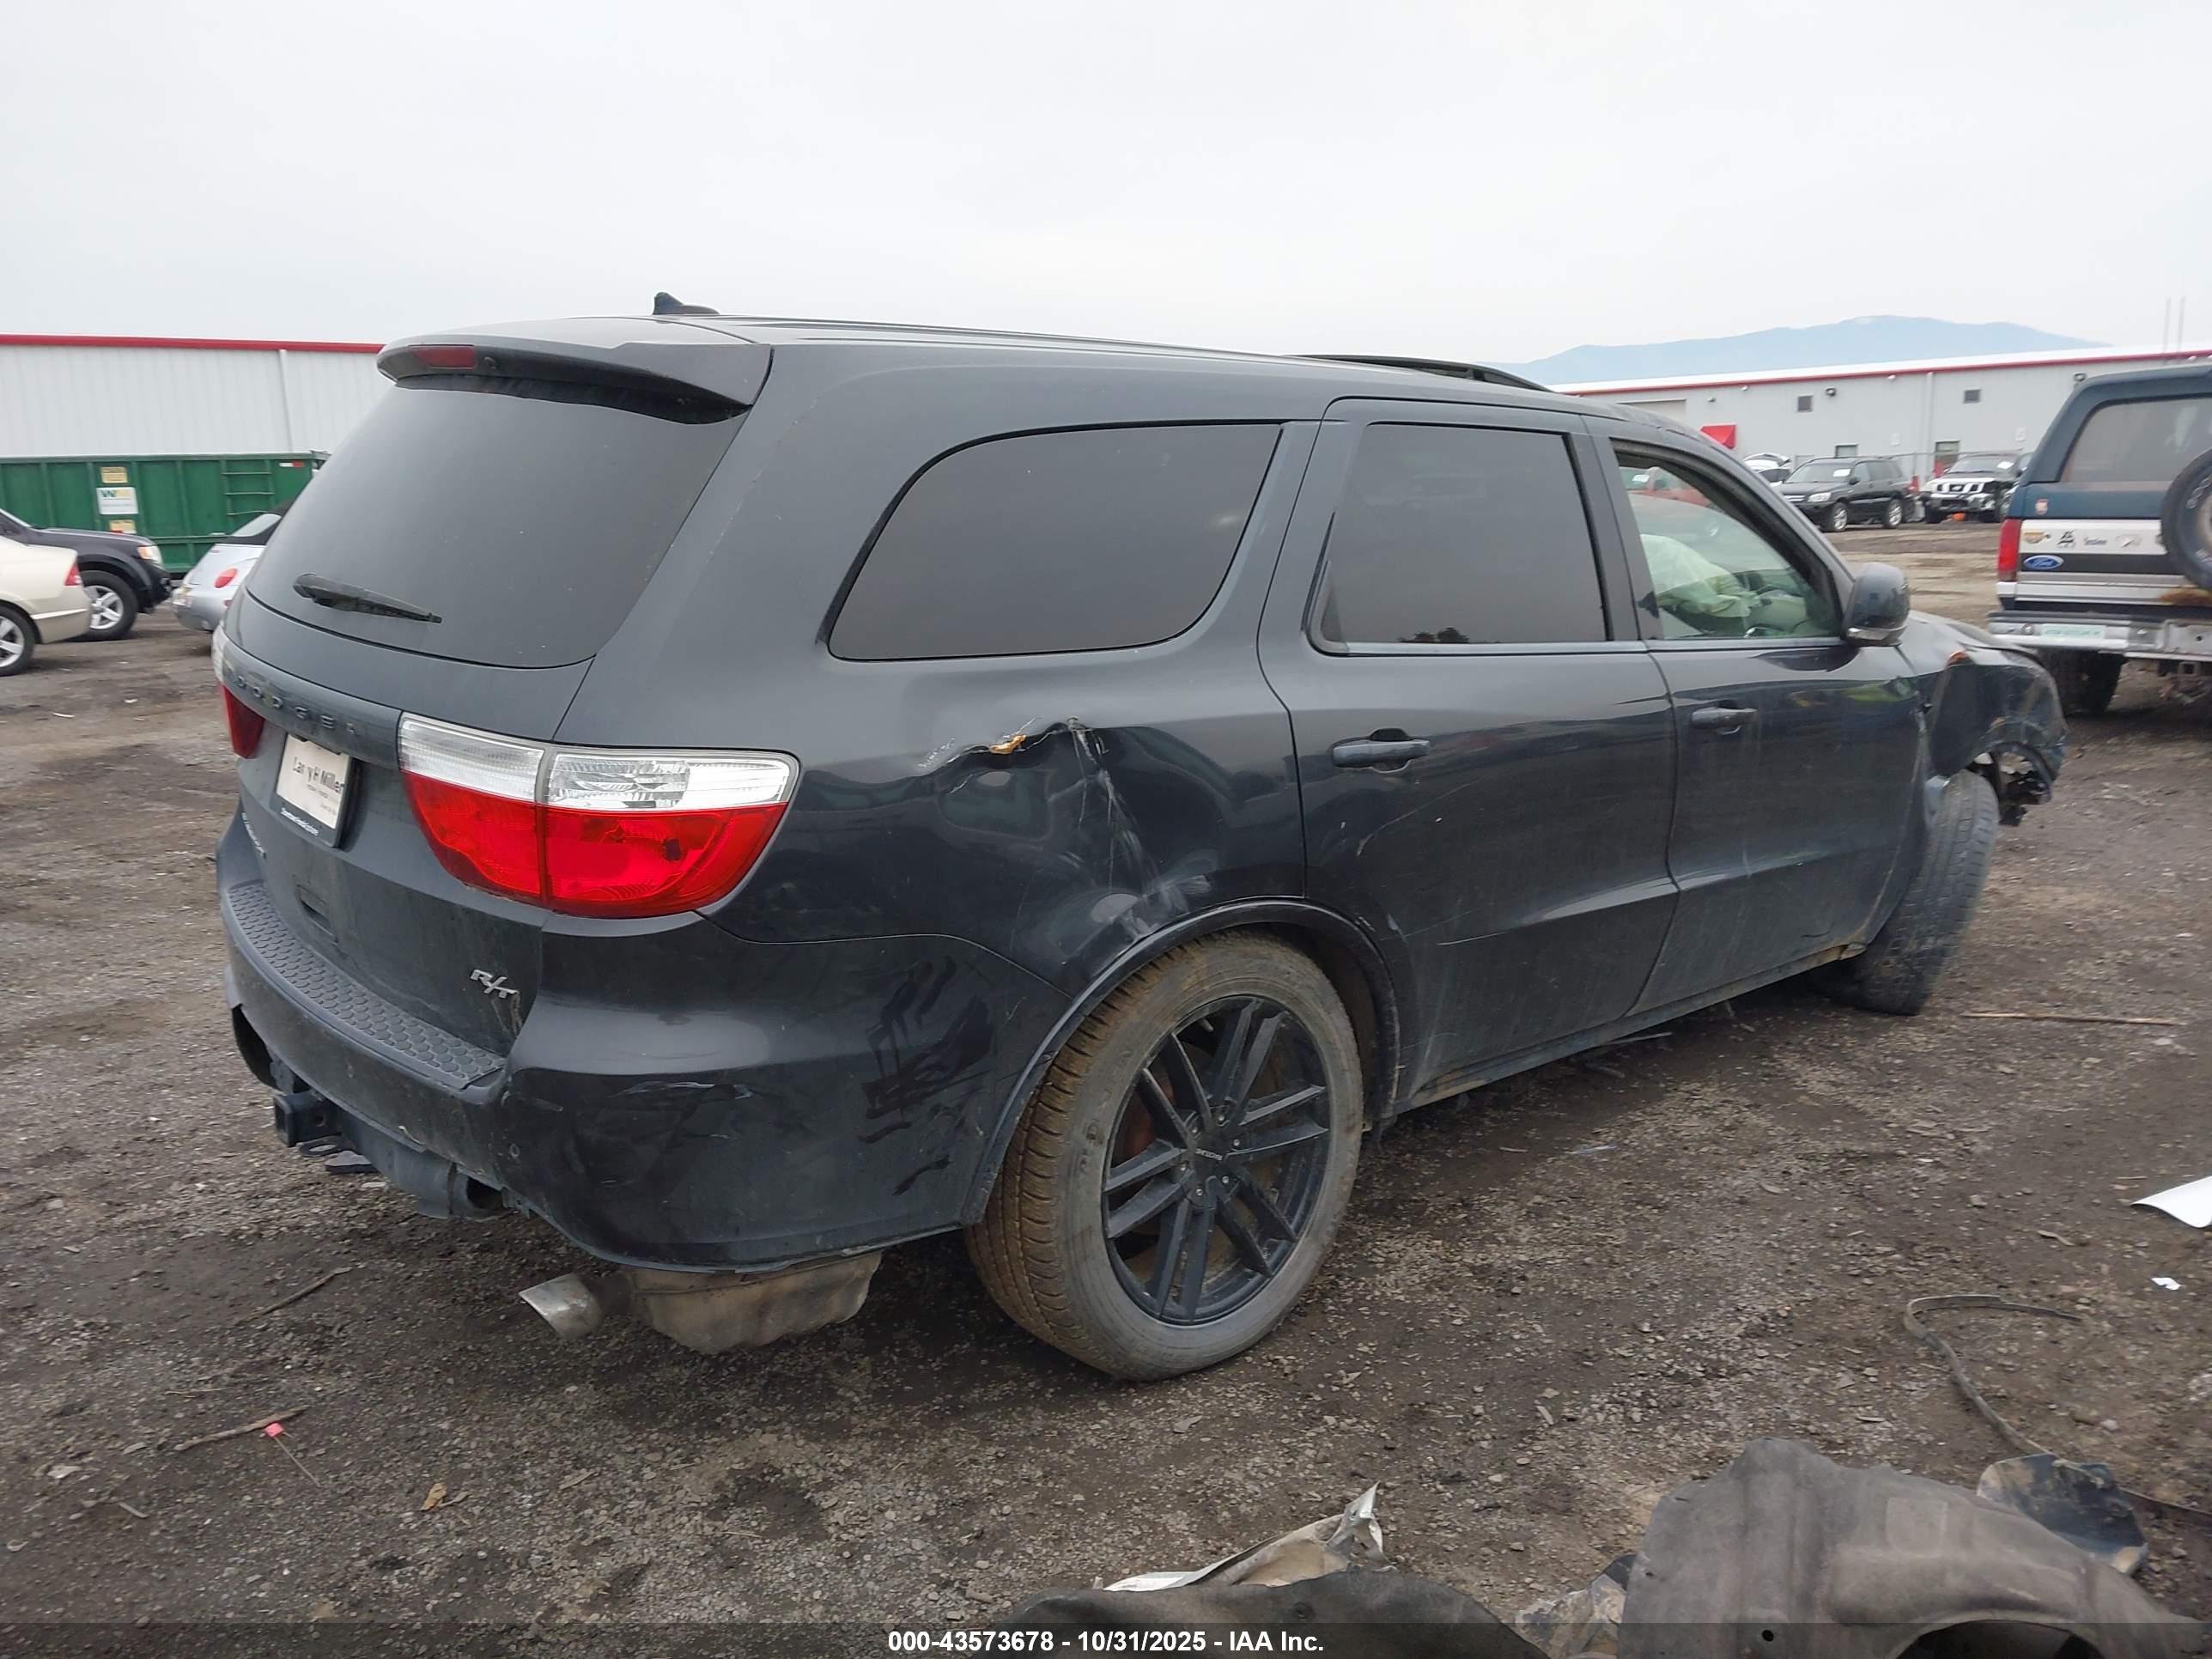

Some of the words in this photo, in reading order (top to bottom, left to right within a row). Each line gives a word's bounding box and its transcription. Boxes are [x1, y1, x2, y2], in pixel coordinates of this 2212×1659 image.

[237, 675, 335, 729] DODGE
[293, 756, 313, 782] Lary
[470, 969, 519, 999] R/T
